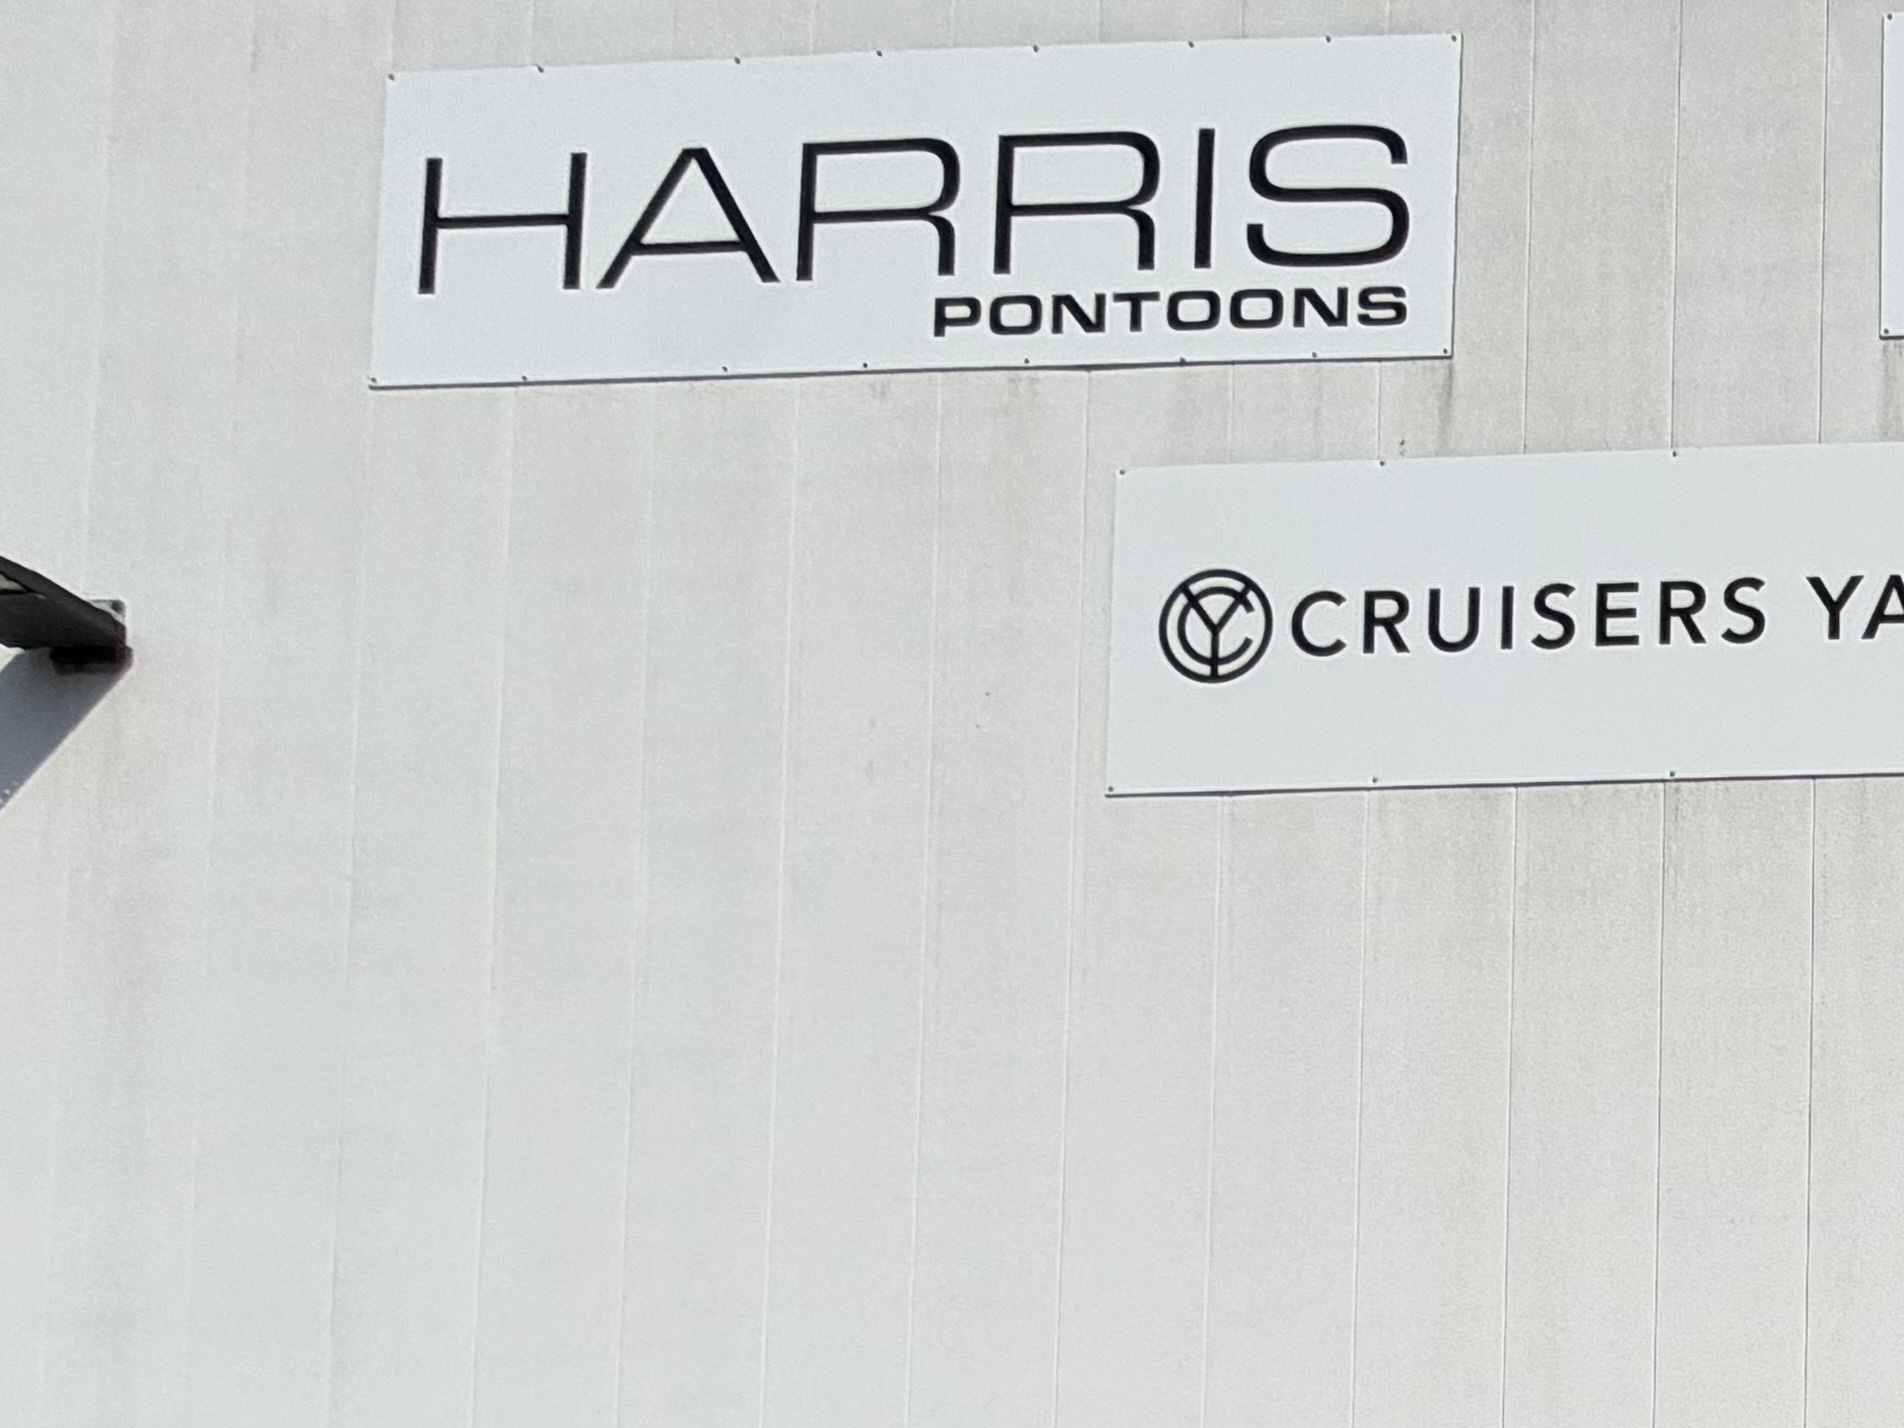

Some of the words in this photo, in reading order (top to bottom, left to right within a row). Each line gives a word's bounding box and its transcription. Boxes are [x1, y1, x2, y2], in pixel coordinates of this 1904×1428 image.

[418, 124, 1411, 296] HARRIS
[932, 284, 1408, 339] PONTOONS
[1290, 576, 1767, 657] CRUISERS
